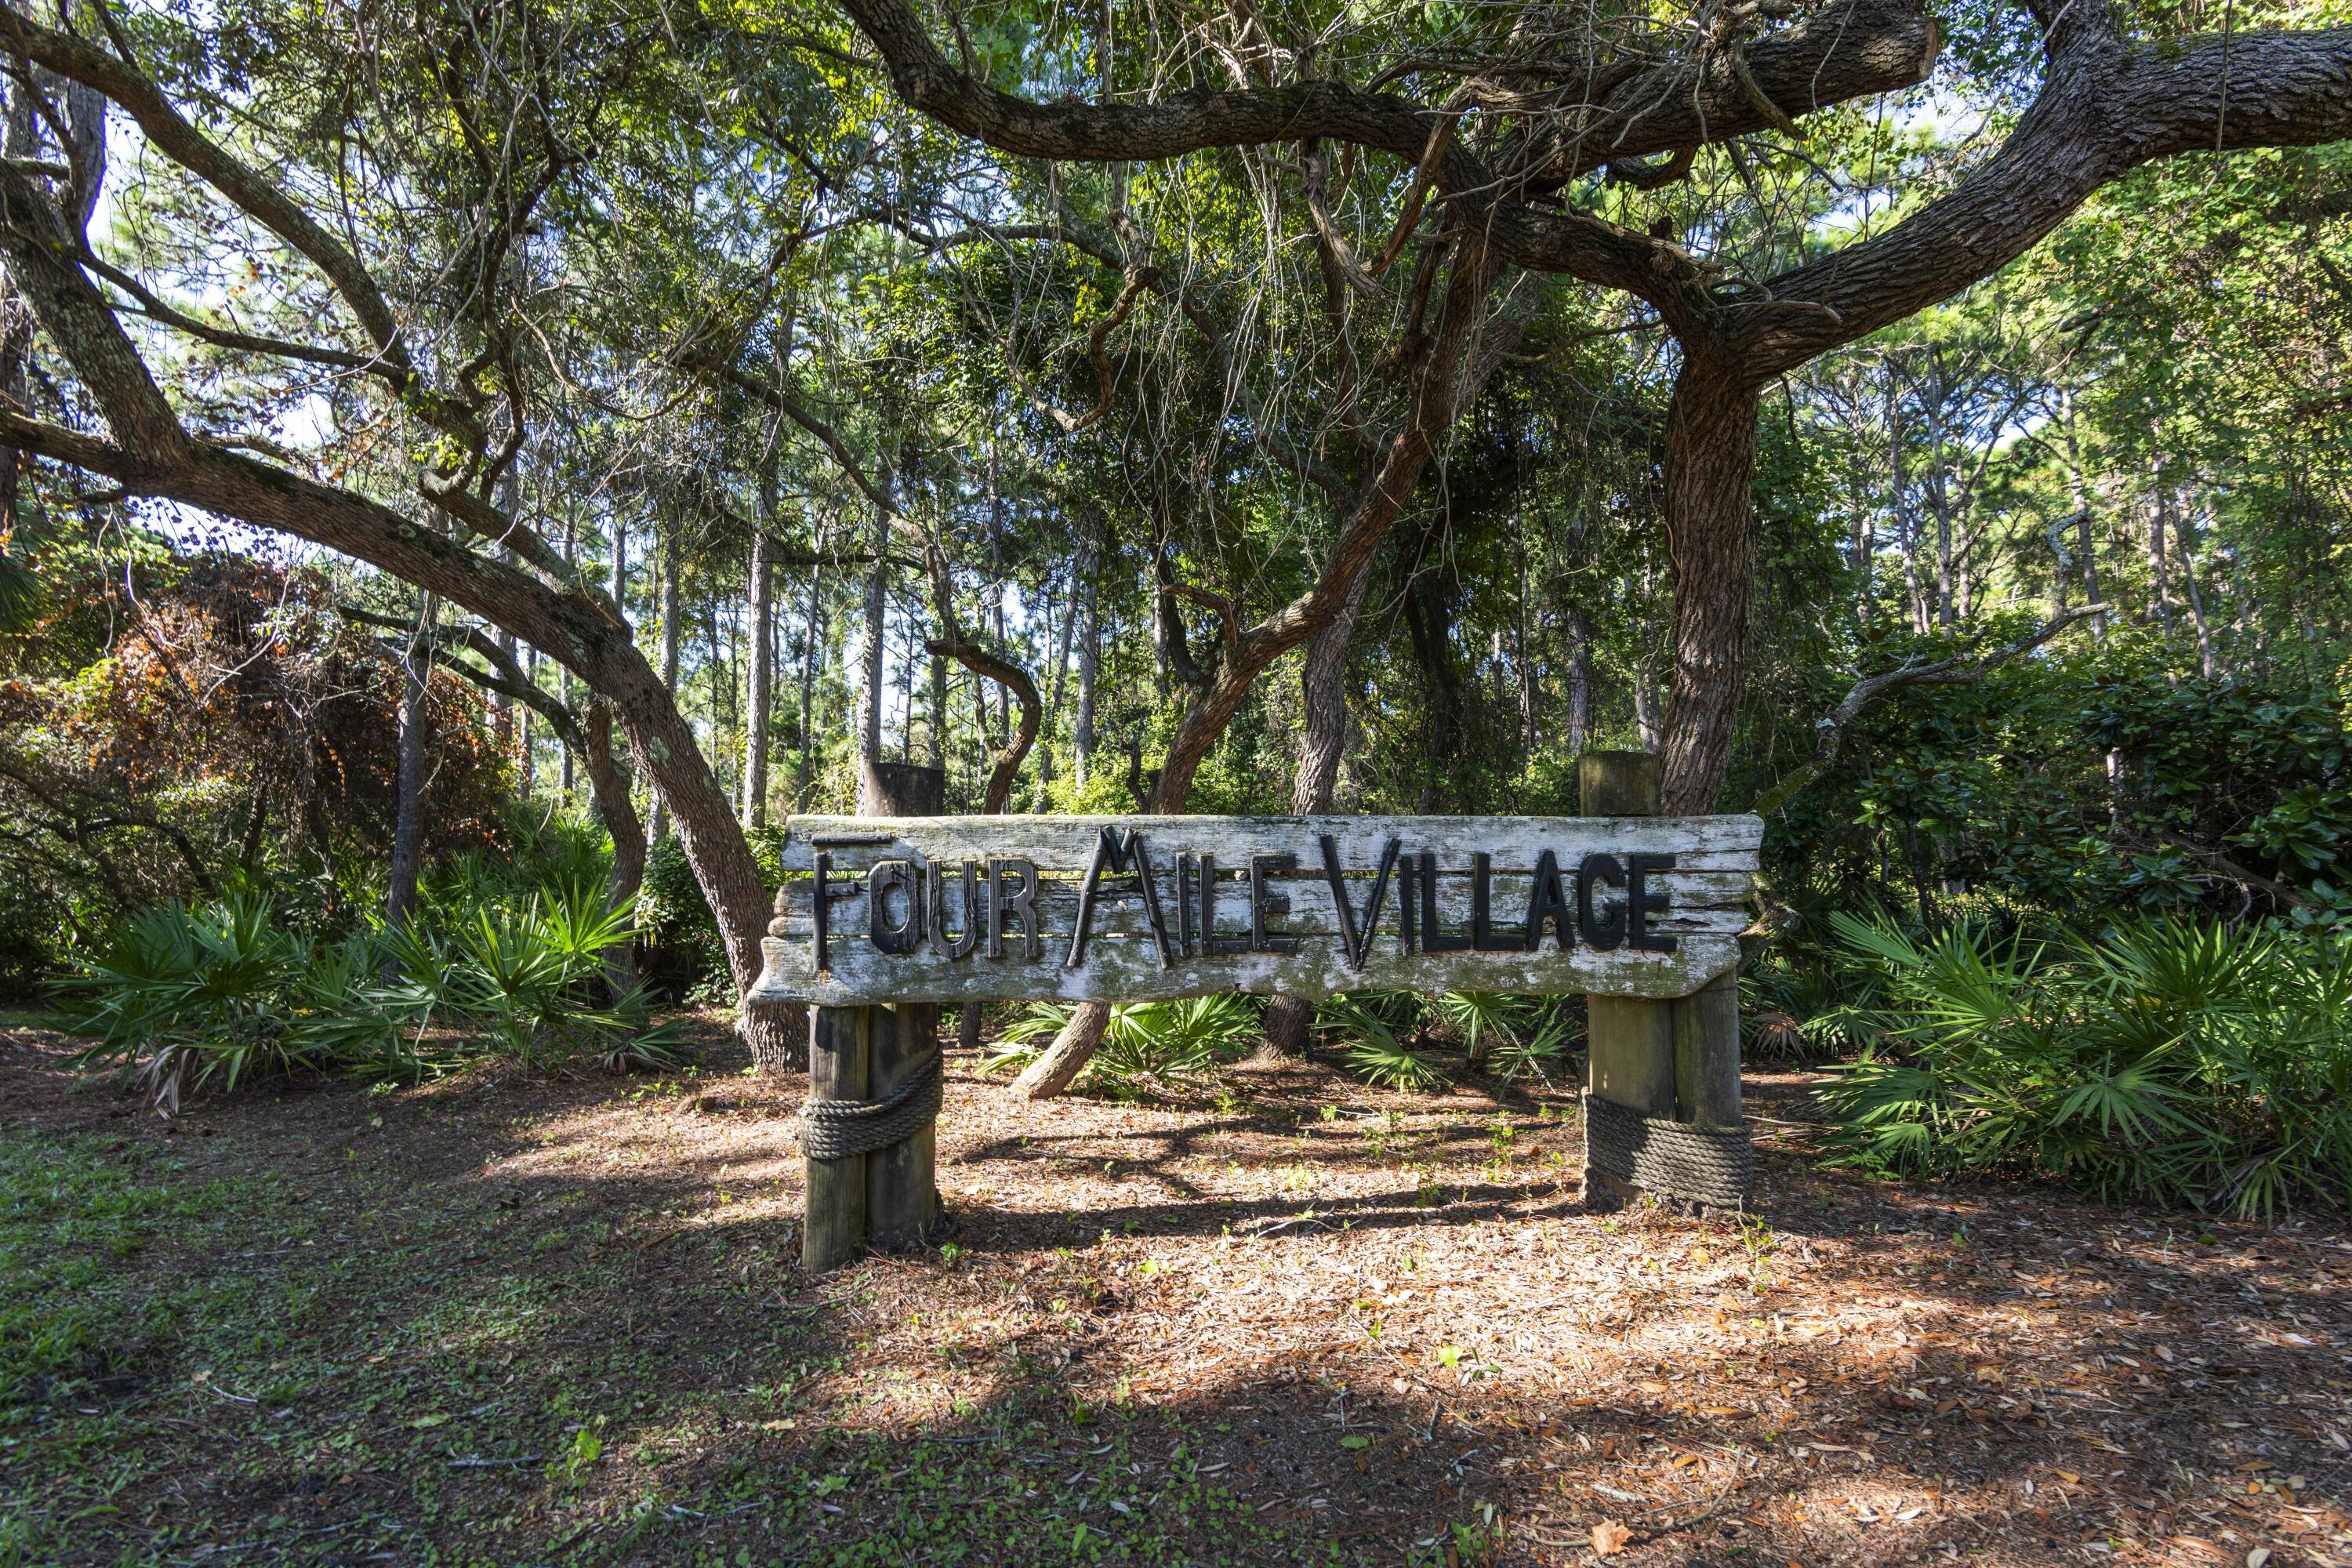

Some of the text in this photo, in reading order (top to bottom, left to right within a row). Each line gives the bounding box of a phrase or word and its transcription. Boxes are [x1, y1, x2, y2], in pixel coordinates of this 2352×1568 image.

[811, 826, 1677, 972] FOUR MILE VILLAGE
